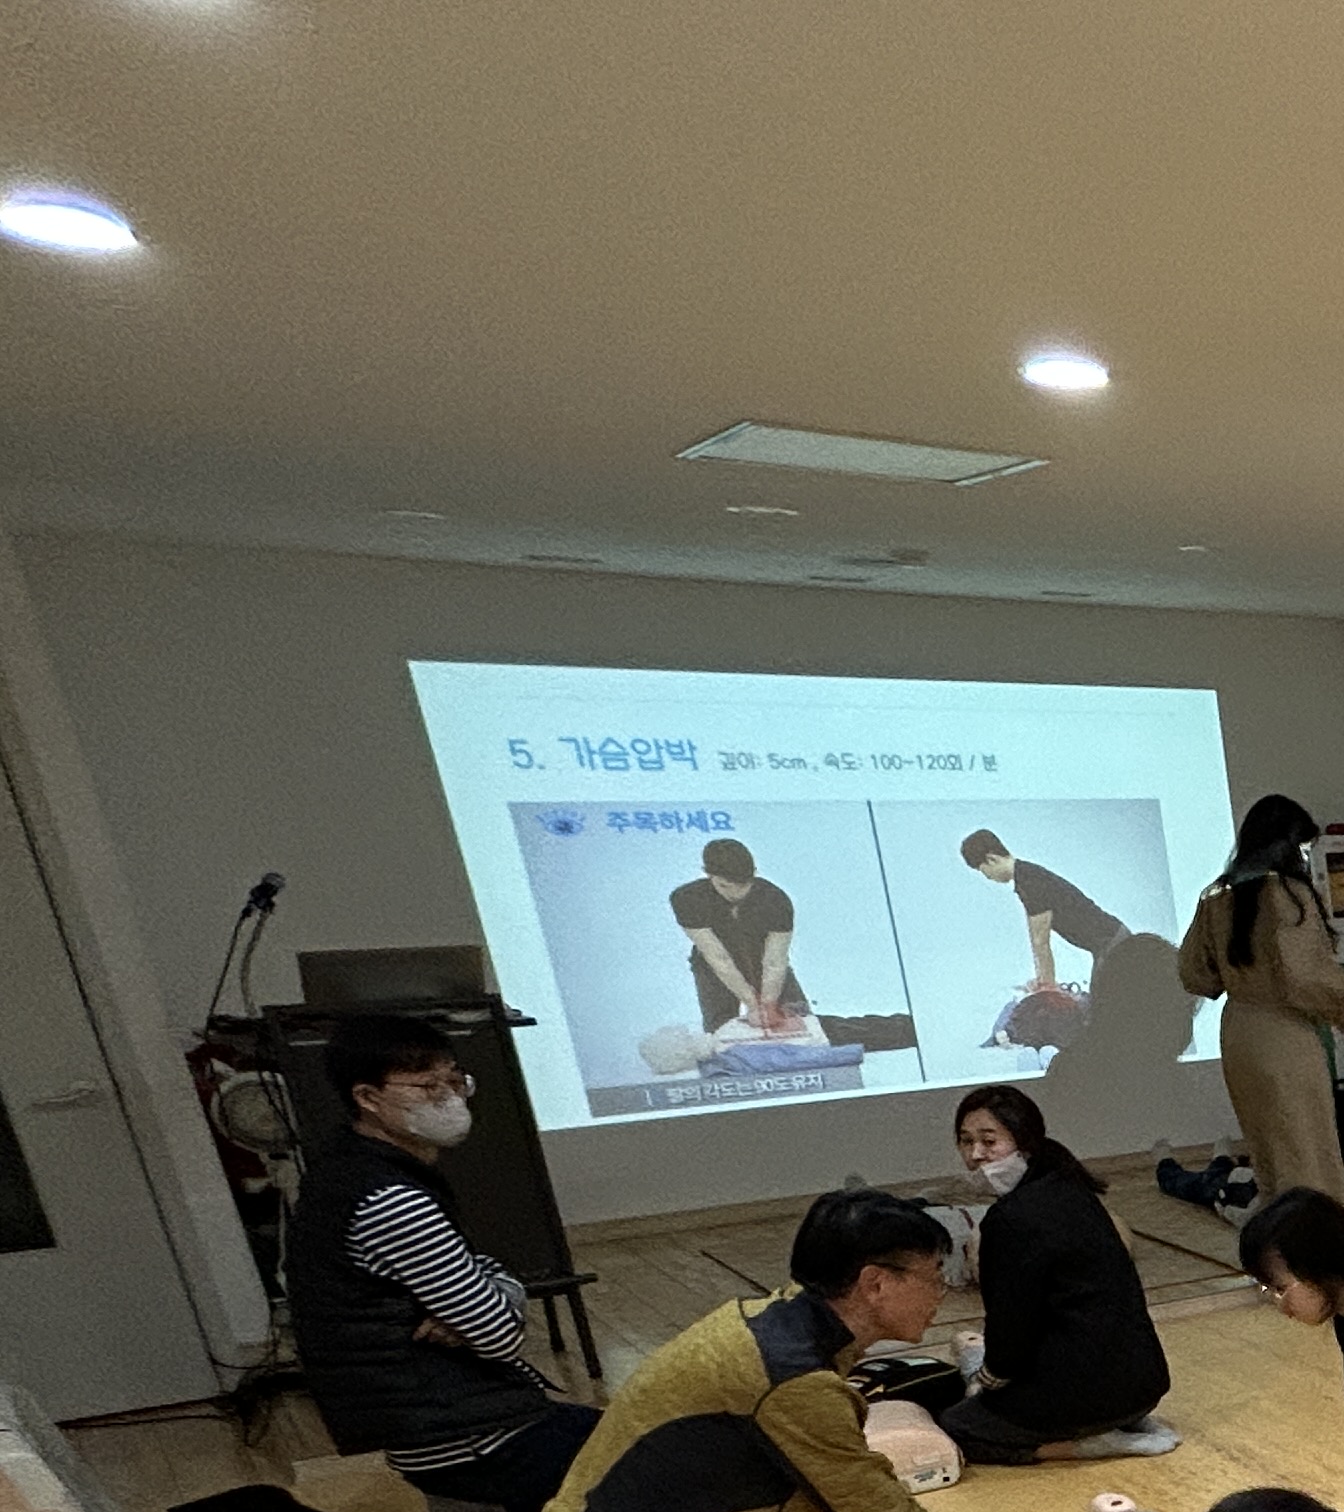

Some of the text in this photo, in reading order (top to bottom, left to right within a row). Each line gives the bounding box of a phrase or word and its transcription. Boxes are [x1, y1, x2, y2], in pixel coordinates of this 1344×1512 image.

[507, 736, 699, 772] 5. 가슴압박
[606, 810, 736, 834] 주목하세요
